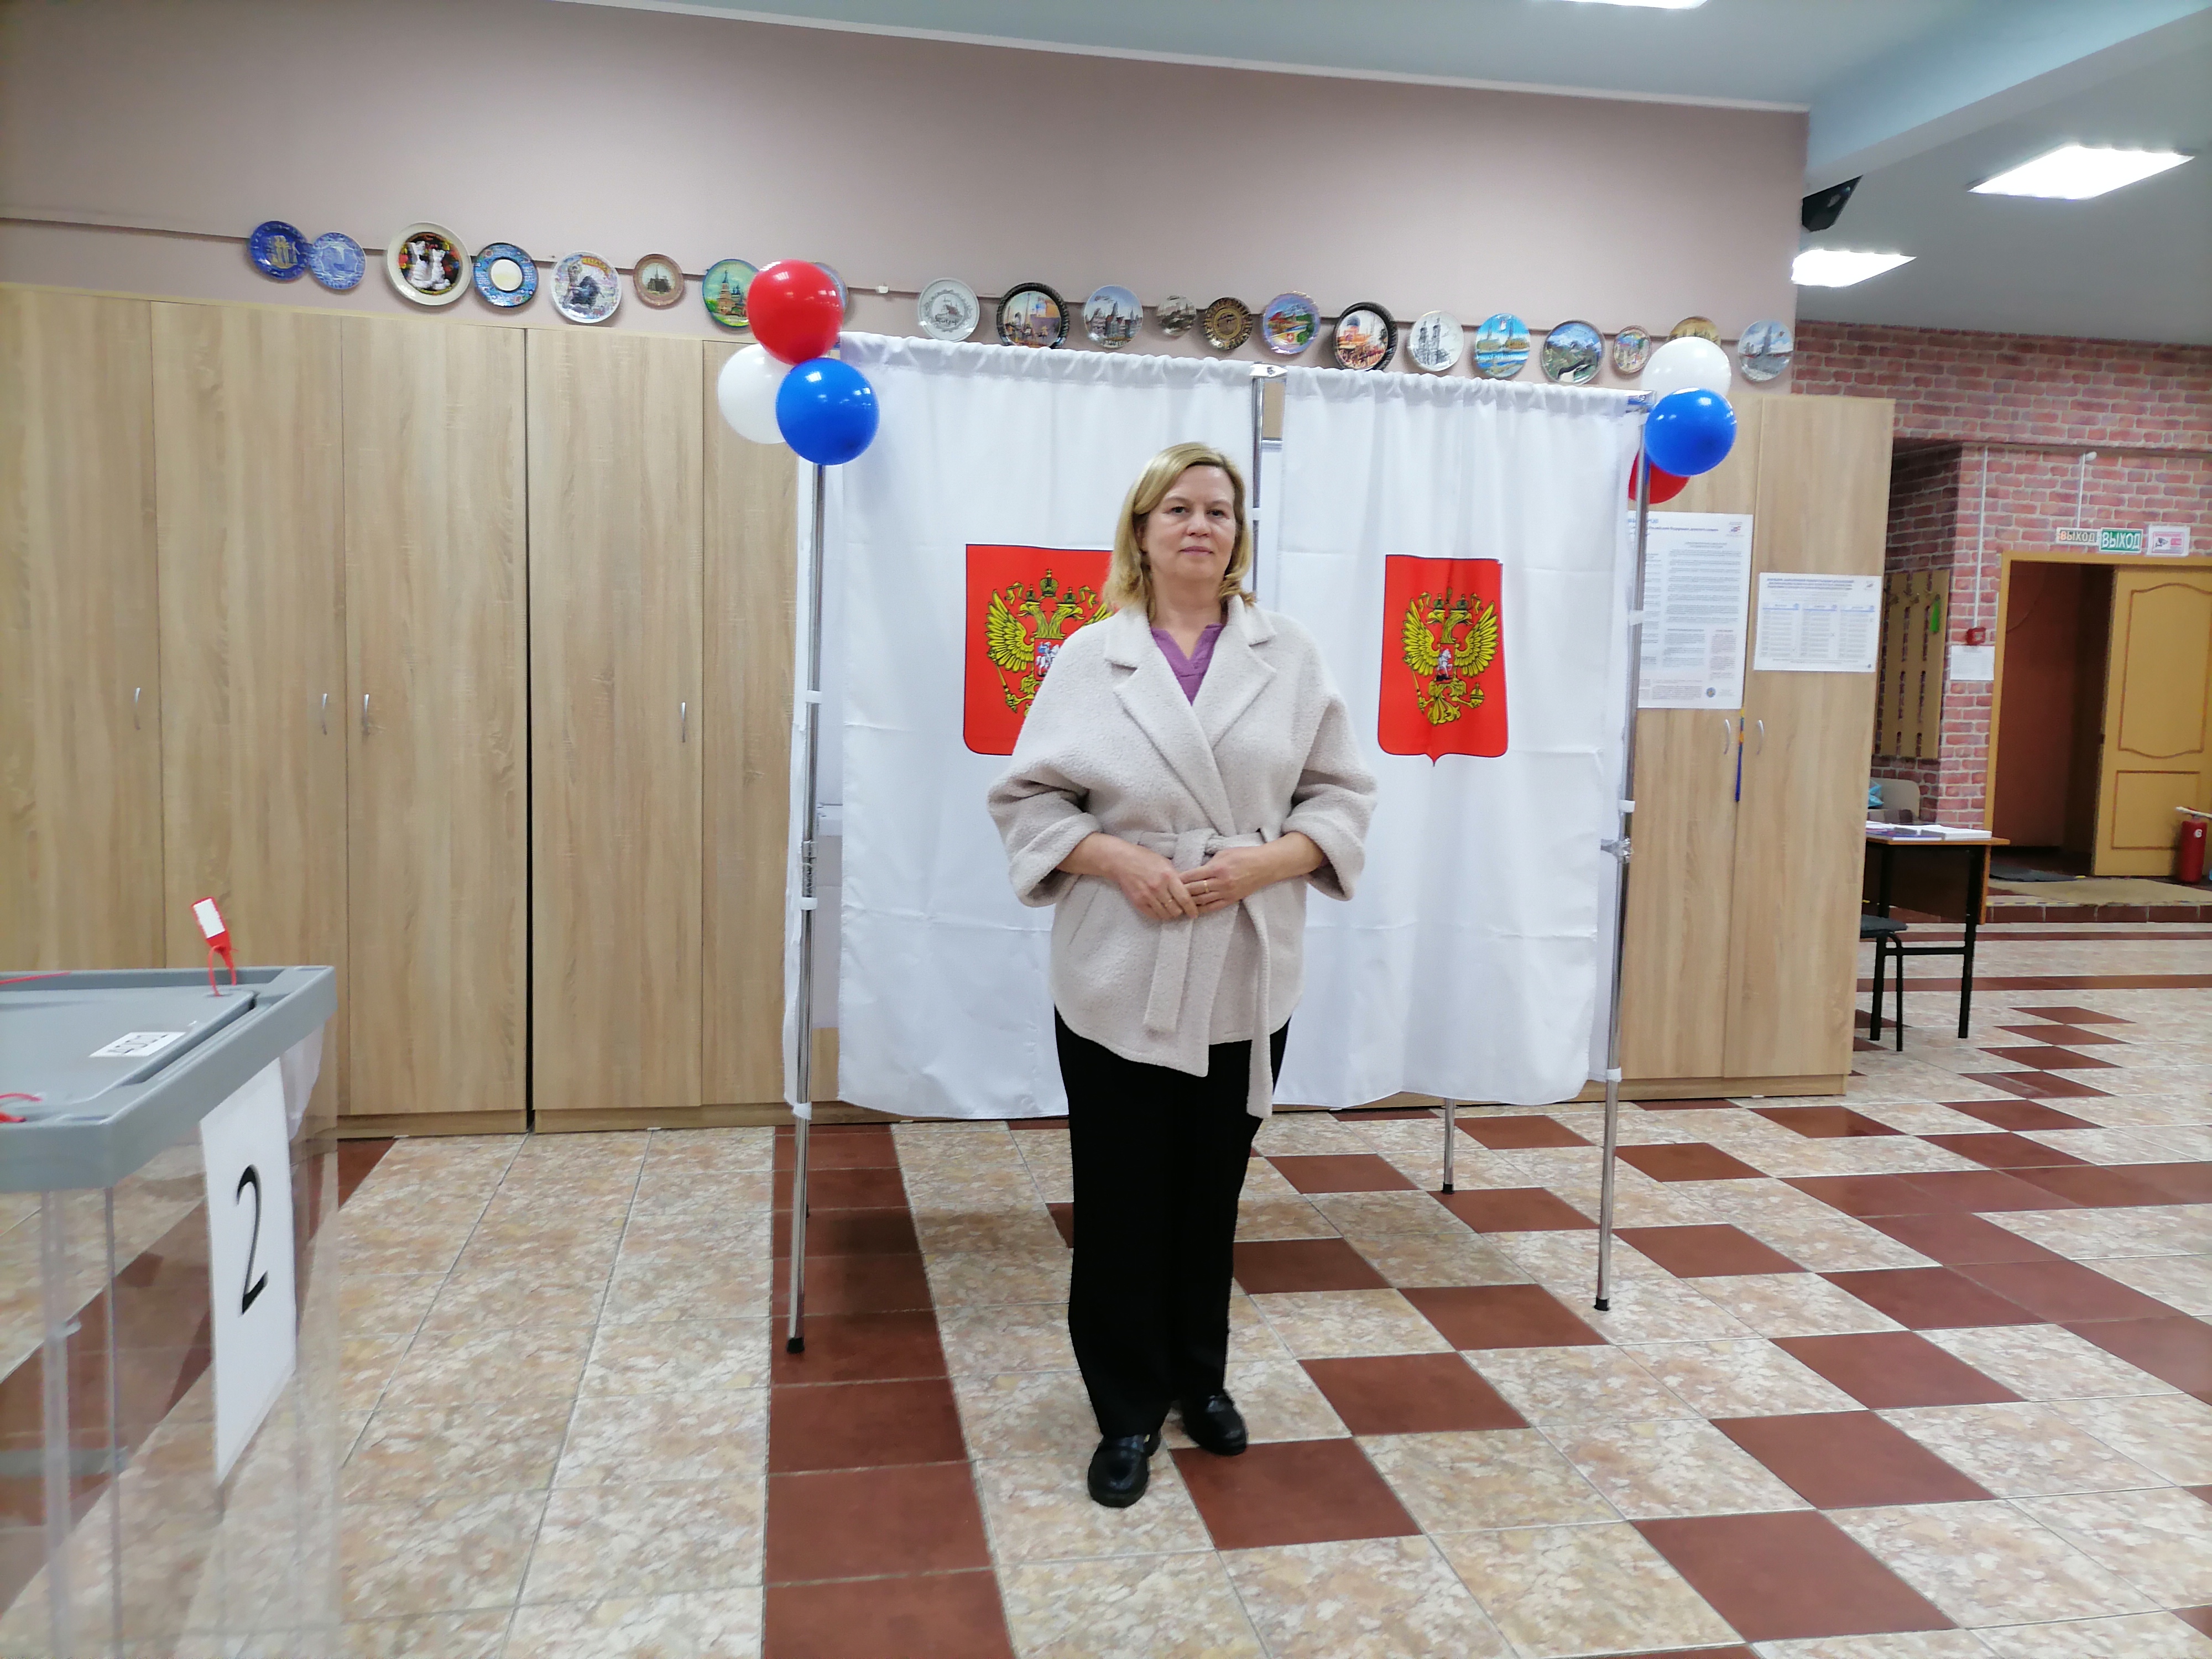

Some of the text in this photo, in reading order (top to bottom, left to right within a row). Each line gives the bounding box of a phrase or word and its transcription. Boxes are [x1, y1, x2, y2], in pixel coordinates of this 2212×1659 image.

[2059, 530, 2095, 543] ВЫХОД
[2102, 531, 2141, 550] ВЫХОД
[236, 1164, 269, 1316] 2
